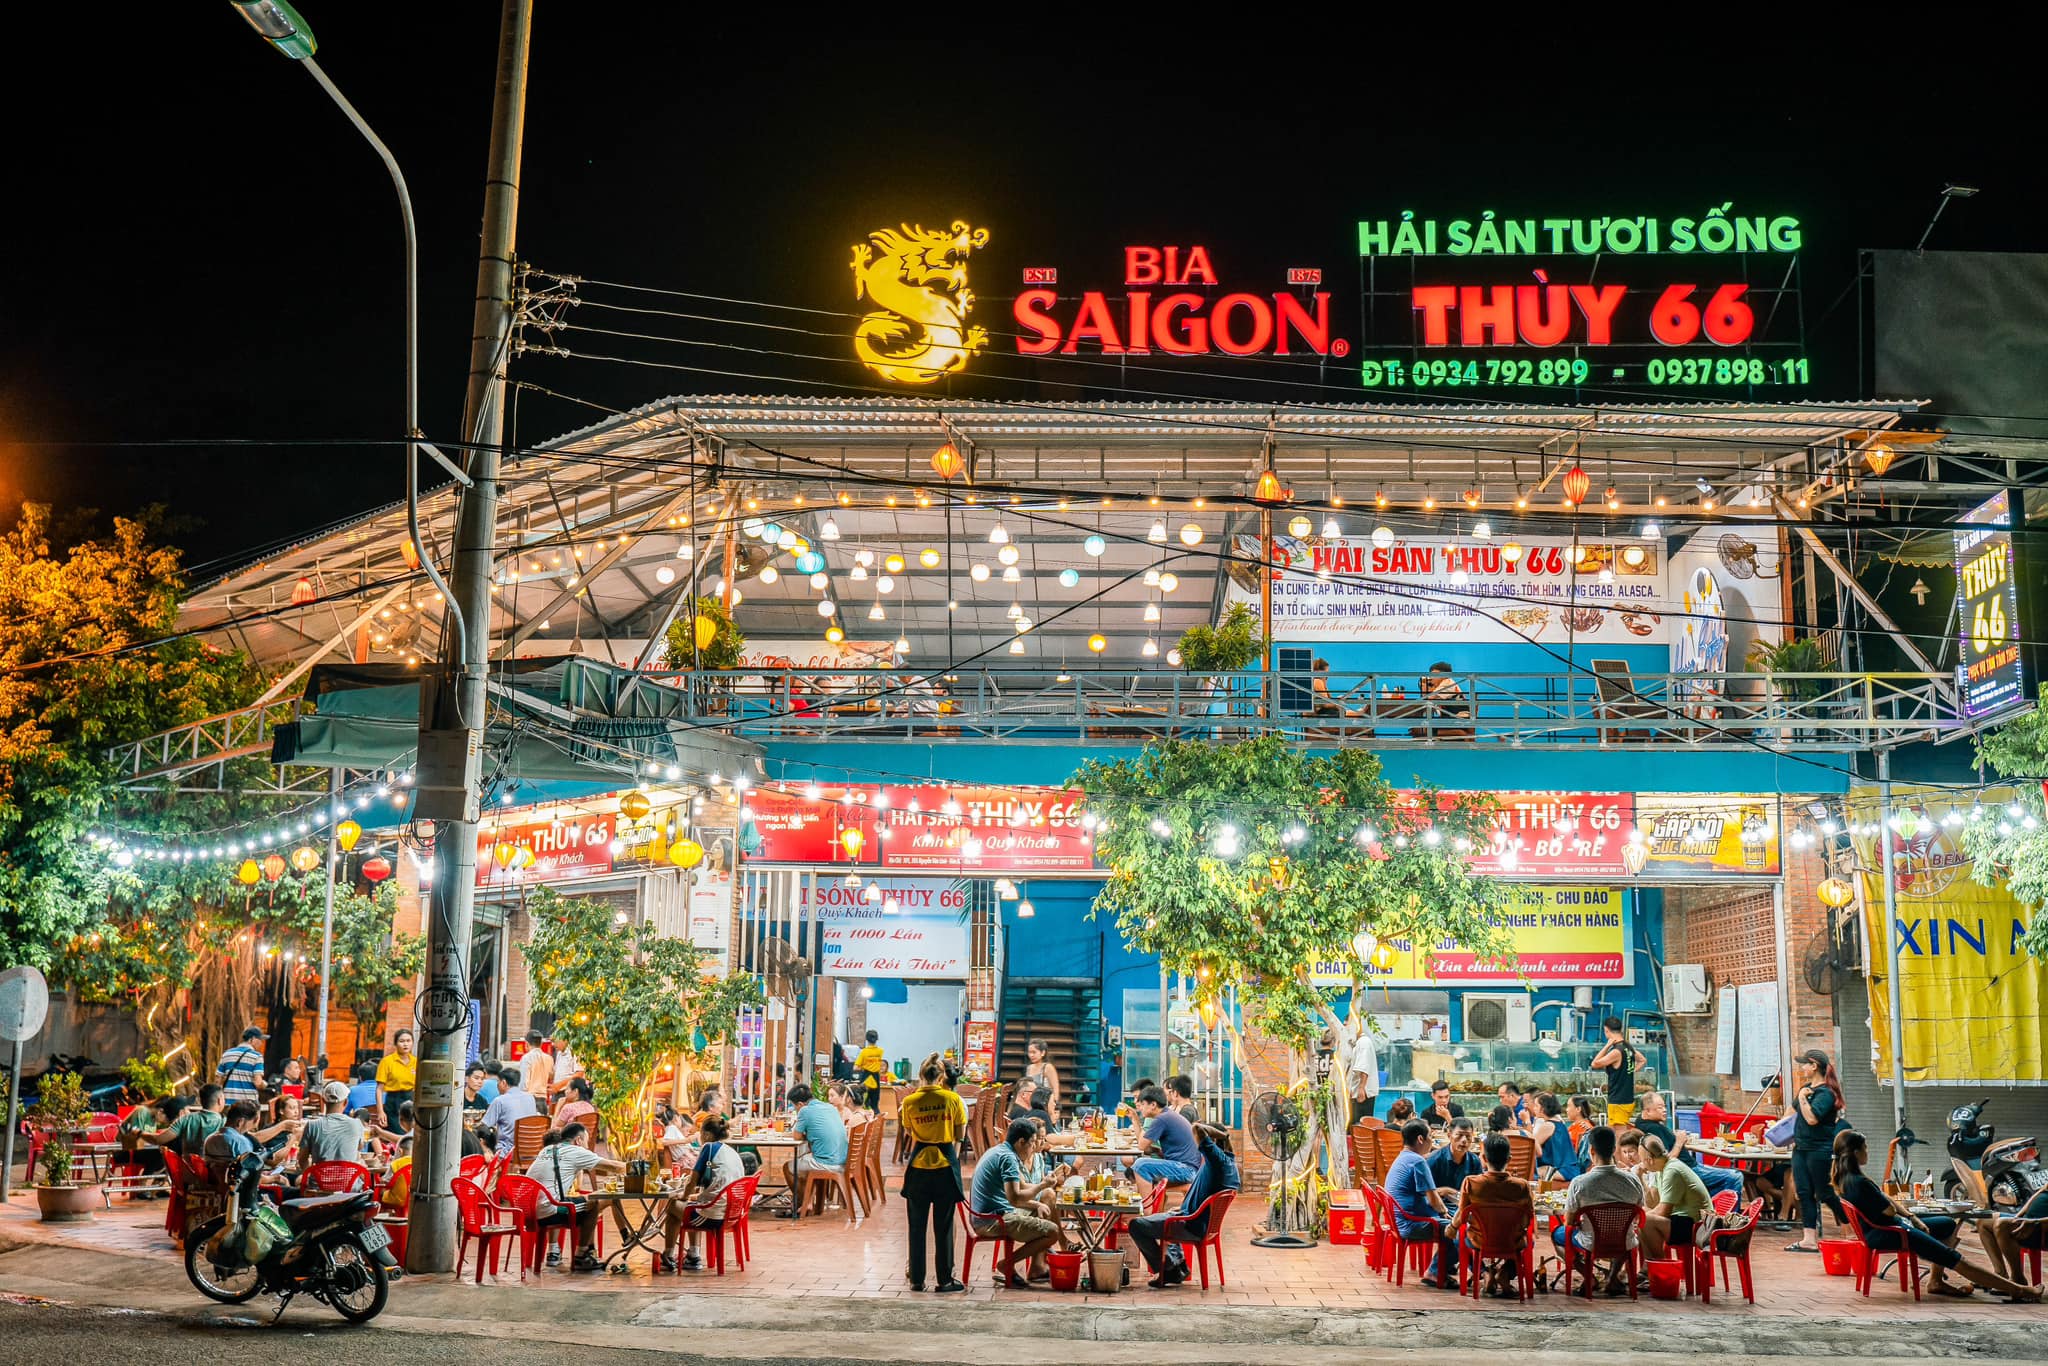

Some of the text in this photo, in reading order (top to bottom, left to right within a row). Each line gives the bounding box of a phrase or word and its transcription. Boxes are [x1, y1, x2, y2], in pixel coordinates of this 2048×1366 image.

[1358, 201, 1802, 256] HẢI SẢN TƯƠI SỐNG
[1125, 247, 1218, 285] BIA
[1290, 269, 1320, 281] 1875
[1411, 269, 1755, 347] THÙY 66
[1013, 290, 1330, 355] SAIGON
[1361, 361, 1405, 386] ĐT:
[1412, 360, 1479, 385] 0934
[1486, 360, 1533, 385] 792
[1538, 359, 1588, 385] 899
[1372, 540, 1434, 574] SẢN
[1527, 547, 1563, 574] 66
[1962, 542, 2008, 600] THÙY
[1588, 585, 1616, 598] CRAB,
[1327, 603, 1347, 616] SINH
[1973, 593, 2006, 653] 66
[1590, 804, 1621, 830] 66
[939, 889, 965, 908] 66
[1556, 891, 1580, 904] CHU
[818, 906, 843, 920] Quý
[844, 906, 883, 919] Khách
[1506, 914, 1537, 927] NGHE
[1585, 911, 1619, 927] HÀNG
[850, 929, 886, 939] 1000
[1896, 918, 1986, 955] XIN
[1433, 959, 1463, 973] Xin
